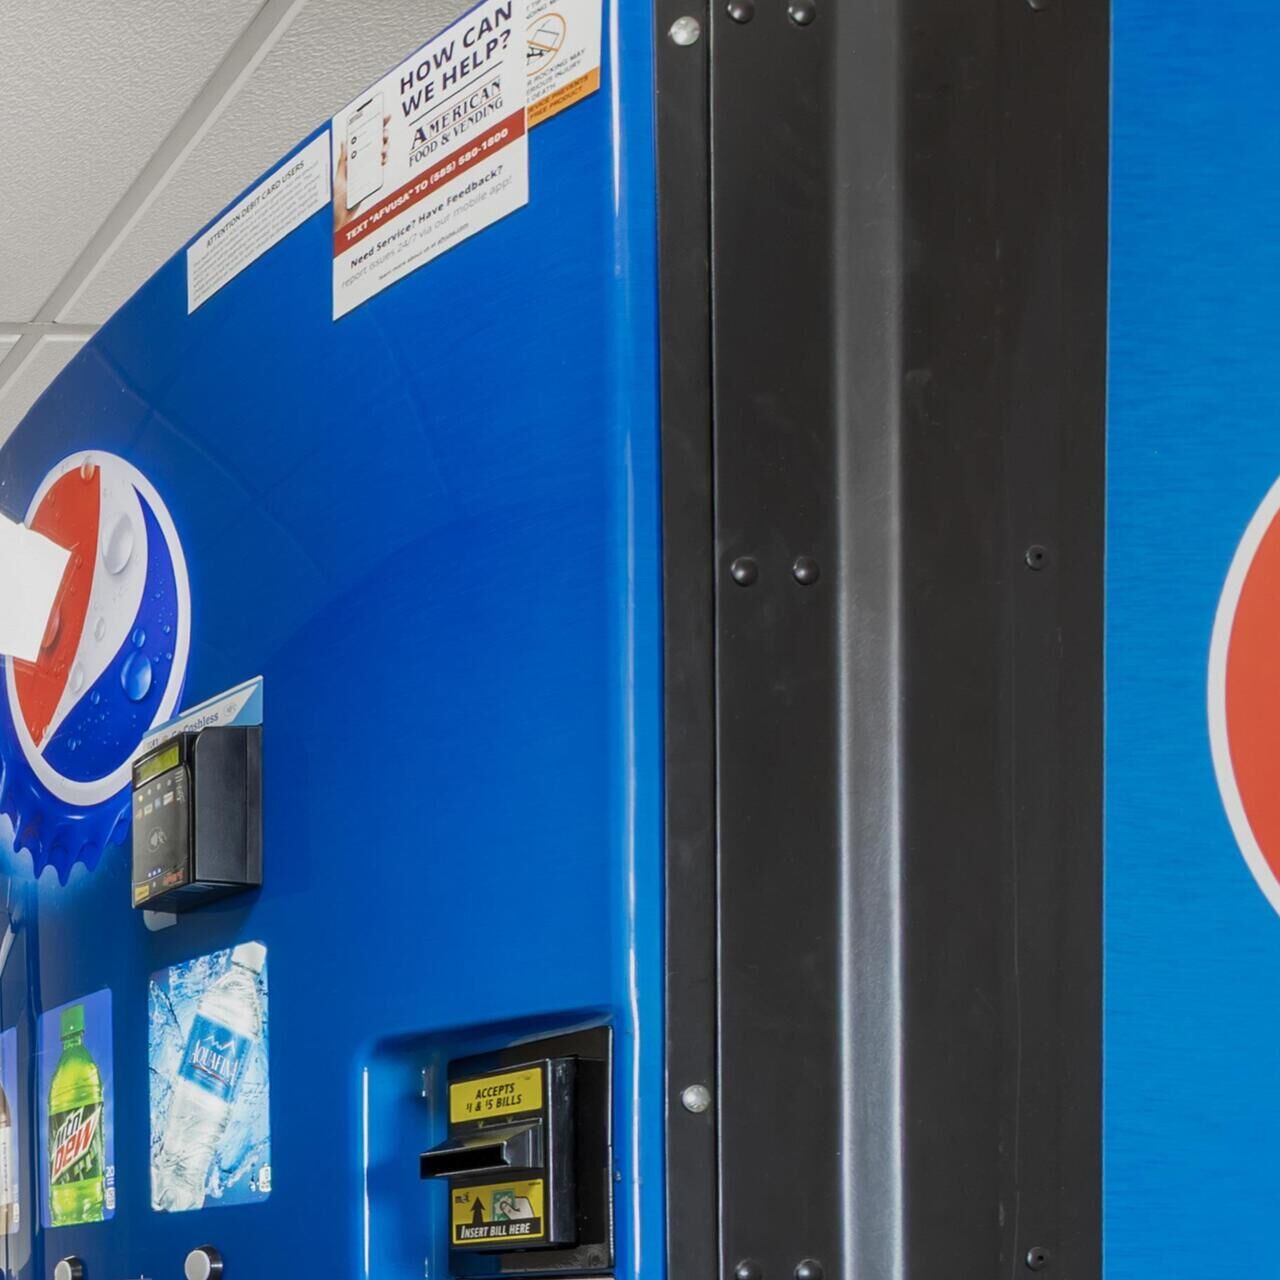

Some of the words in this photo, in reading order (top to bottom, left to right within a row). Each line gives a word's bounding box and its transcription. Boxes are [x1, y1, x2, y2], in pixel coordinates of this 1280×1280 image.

[400, 40, 455, 95] HOW
[462, 1, 512, 48] CAN
[402, 81, 434, 117] WE
[442, 29, 511, 90] HELP?
[409, 140, 438, 167] FOOD
[441, 131, 452, 145] &
[453, 97, 503, 136] VENDING
[411, 78, 501, 150] AMERICAN
[206, 215, 241, 248] ATTENTION
[241, 196, 261, 218] DEBIT
[261, 180, 282, 200] CARD
[282, 160, 305, 183] USERS
[346, 219, 369, 241] TEXT
[414, 180, 429, 195] TO
[350, 248, 374, 269] Need
[376, 219, 417, 252] Service?
[418, 202, 444, 225] Have
[446, 164, 503, 204] Feedback?
[191, 1039, 238, 1087] AQUAFINA
[475, 1083, 515, 1099] ACCEPTS
[475, 1101, 482, 1111] &
[496, 1094, 522, 1108] BILLS
[460, 1226, 489, 1239] INSERT
[489, 1224, 507, 1236] BILL
[509, 1222, 531, 1234] HERE
